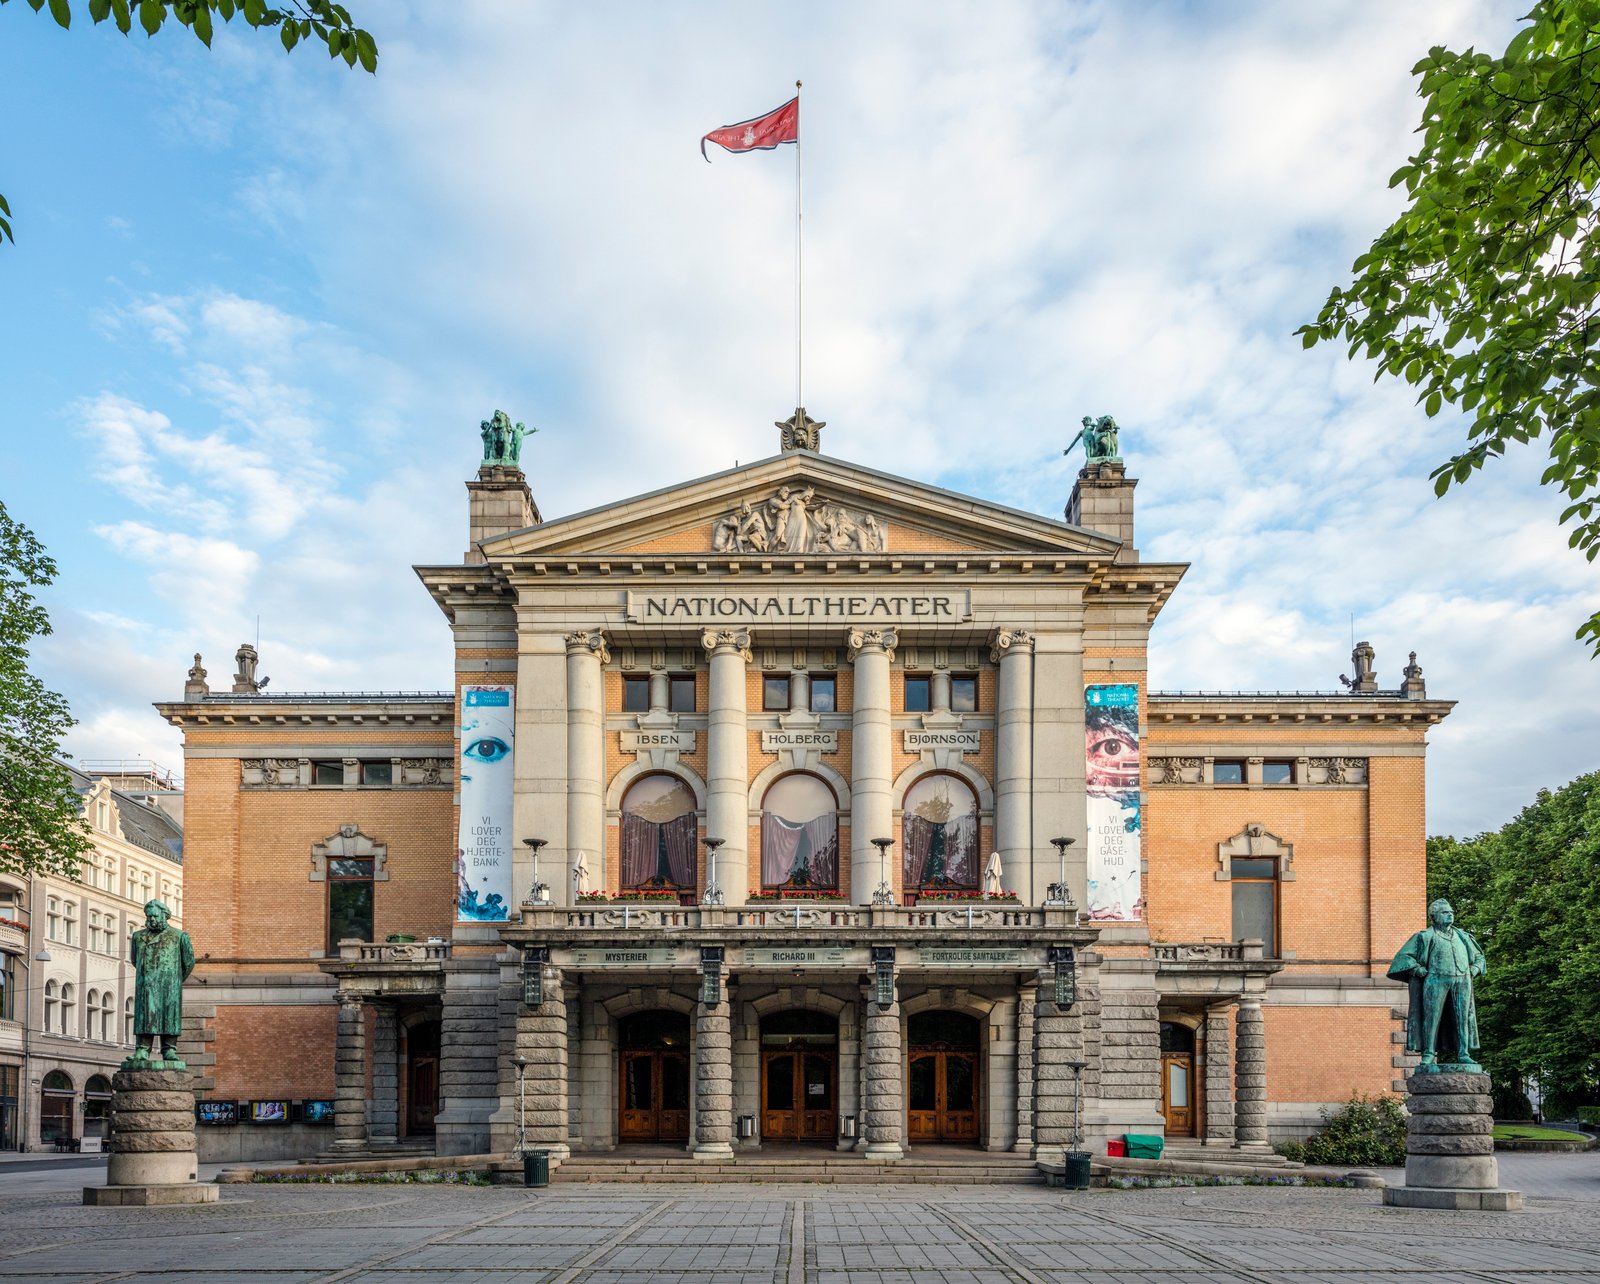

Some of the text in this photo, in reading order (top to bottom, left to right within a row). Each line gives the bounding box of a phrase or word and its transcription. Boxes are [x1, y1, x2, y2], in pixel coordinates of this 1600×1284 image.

[647, 597, 953, 617] NATIONALTHEATER
[636, 735, 680, 745] IBSEN
[768, 734, 831, 744] HOLBERG
[909, 734, 976, 746] BJØRNSON
[482, 816, 490, 825] VI
[1109, 815, 1117, 824] VI
[471, 826, 502, 836] LOVER
[476, 836, 496, 846] DEG
[1104, 835, 1123, 845] DEG
[466, 847, 506, 857] HJERTE-
[473, 857, 499, 867] BANK
[1103, 856, 1124, 866] HUD
[605, 952, 648, 961] MYSTERIER
[772, 952, 815, 961] RICHARD III
[932, 952, 971, 961] FORTROLIGE
[972, 952, 1006, 961] SAMTALER
